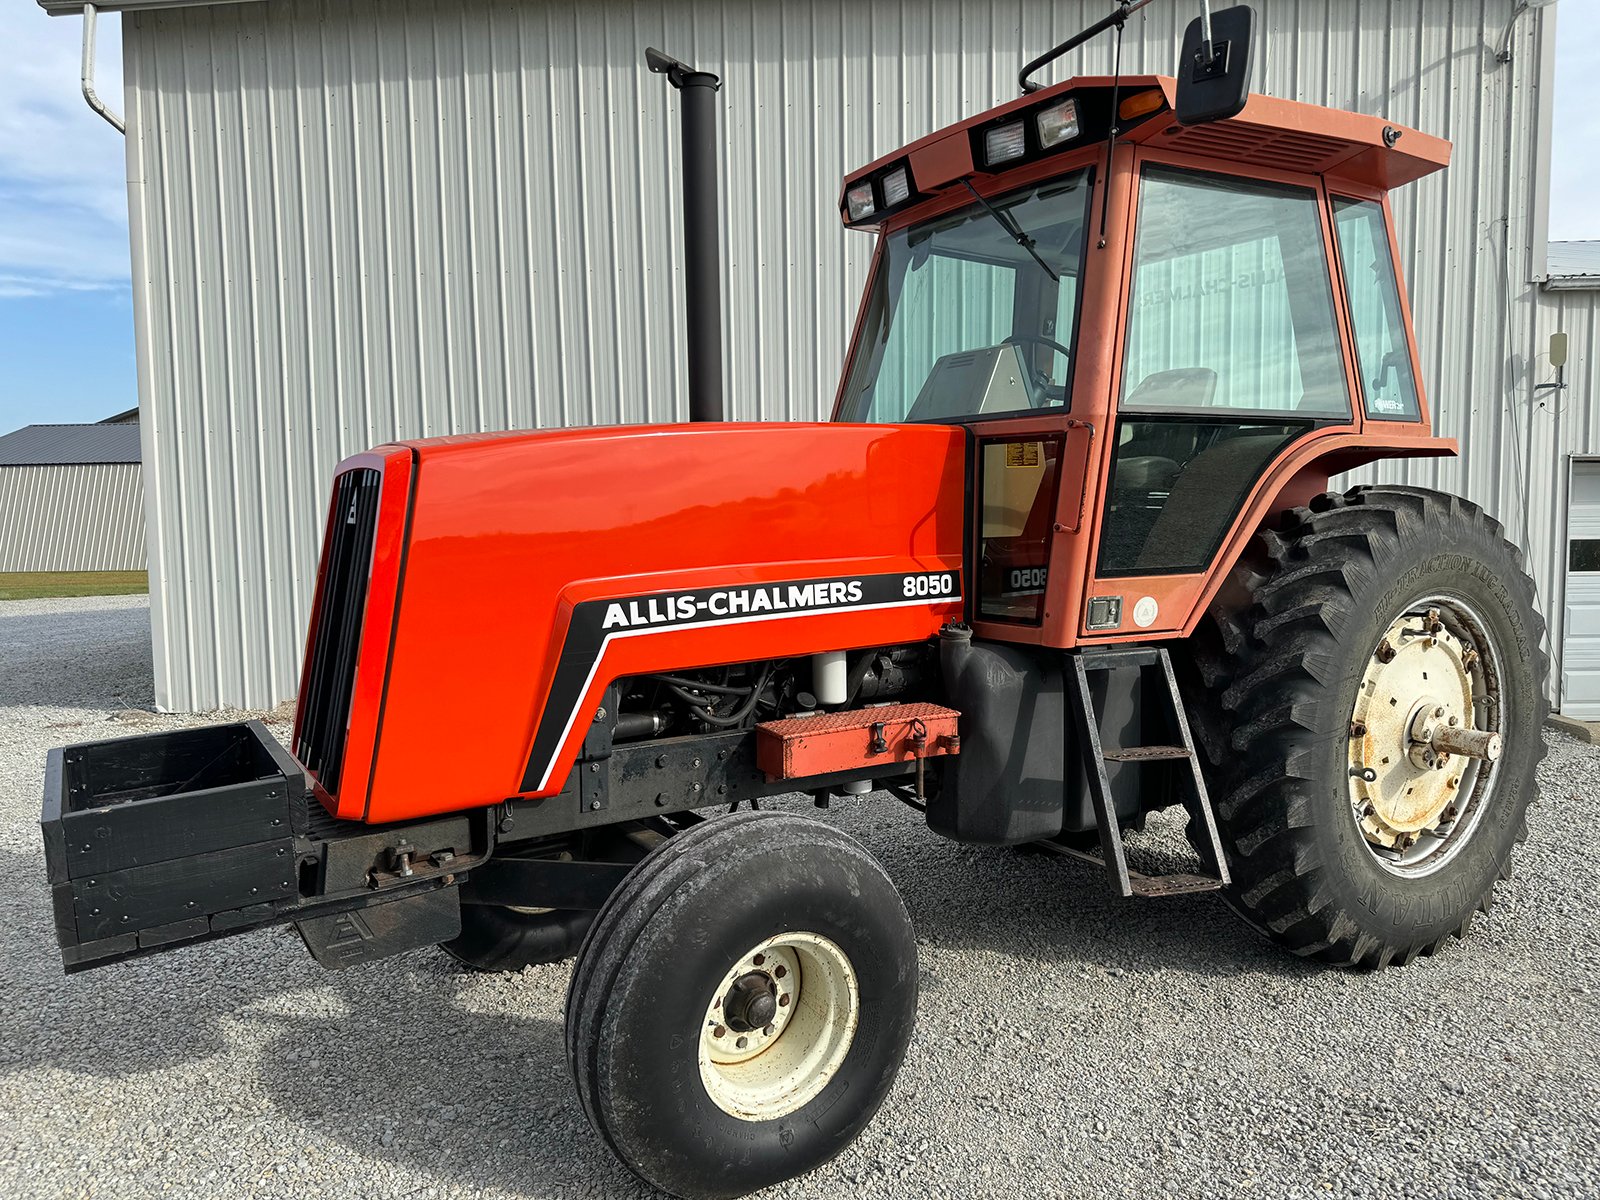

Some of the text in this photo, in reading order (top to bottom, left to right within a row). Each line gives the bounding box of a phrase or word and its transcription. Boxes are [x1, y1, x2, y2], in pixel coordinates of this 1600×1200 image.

[601, 573, 953, 629] ALLIS-CHALMERS 8050
[1373, 553, 1531, 663] HI-TRACTION LUG RADIAL
[1356, 872, 1473, 931] TITAN
